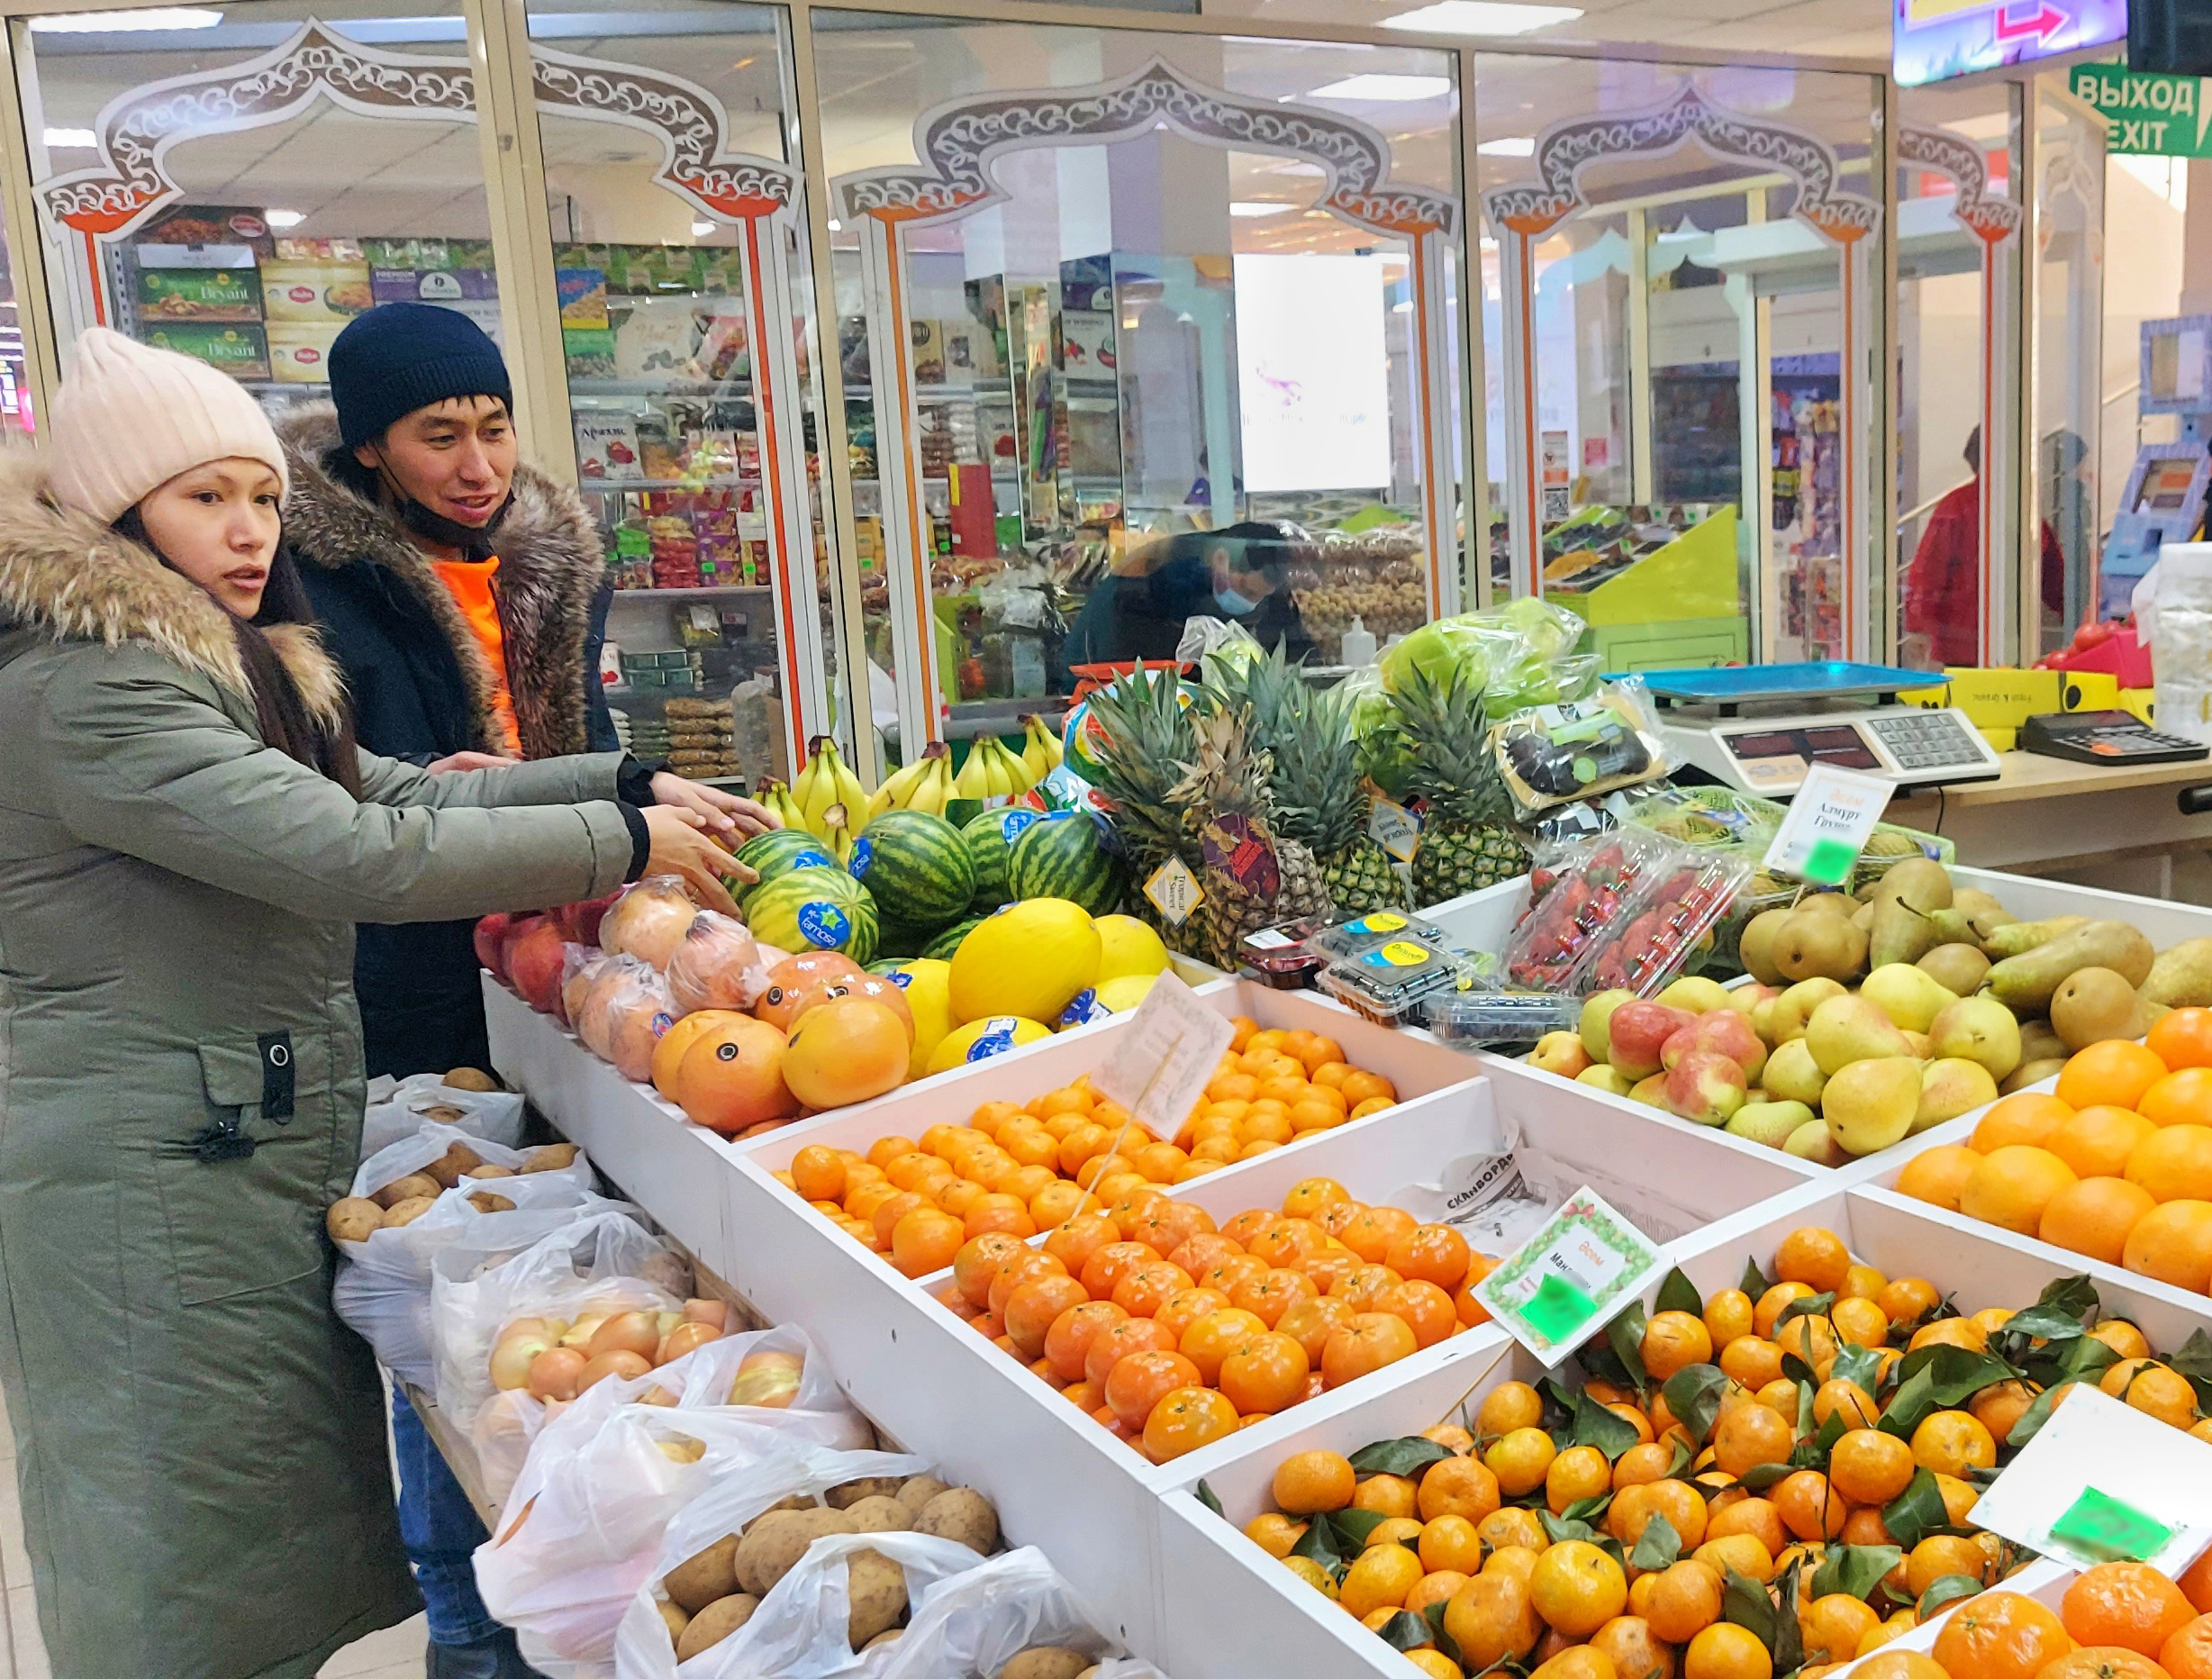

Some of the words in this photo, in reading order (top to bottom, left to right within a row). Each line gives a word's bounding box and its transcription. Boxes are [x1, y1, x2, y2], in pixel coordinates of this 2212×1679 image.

[2077, 74, 2194, 117] ВЫХОД
[2106, 118, 2170, 151] EXIT
[801, 916, 837, 947] famosa
